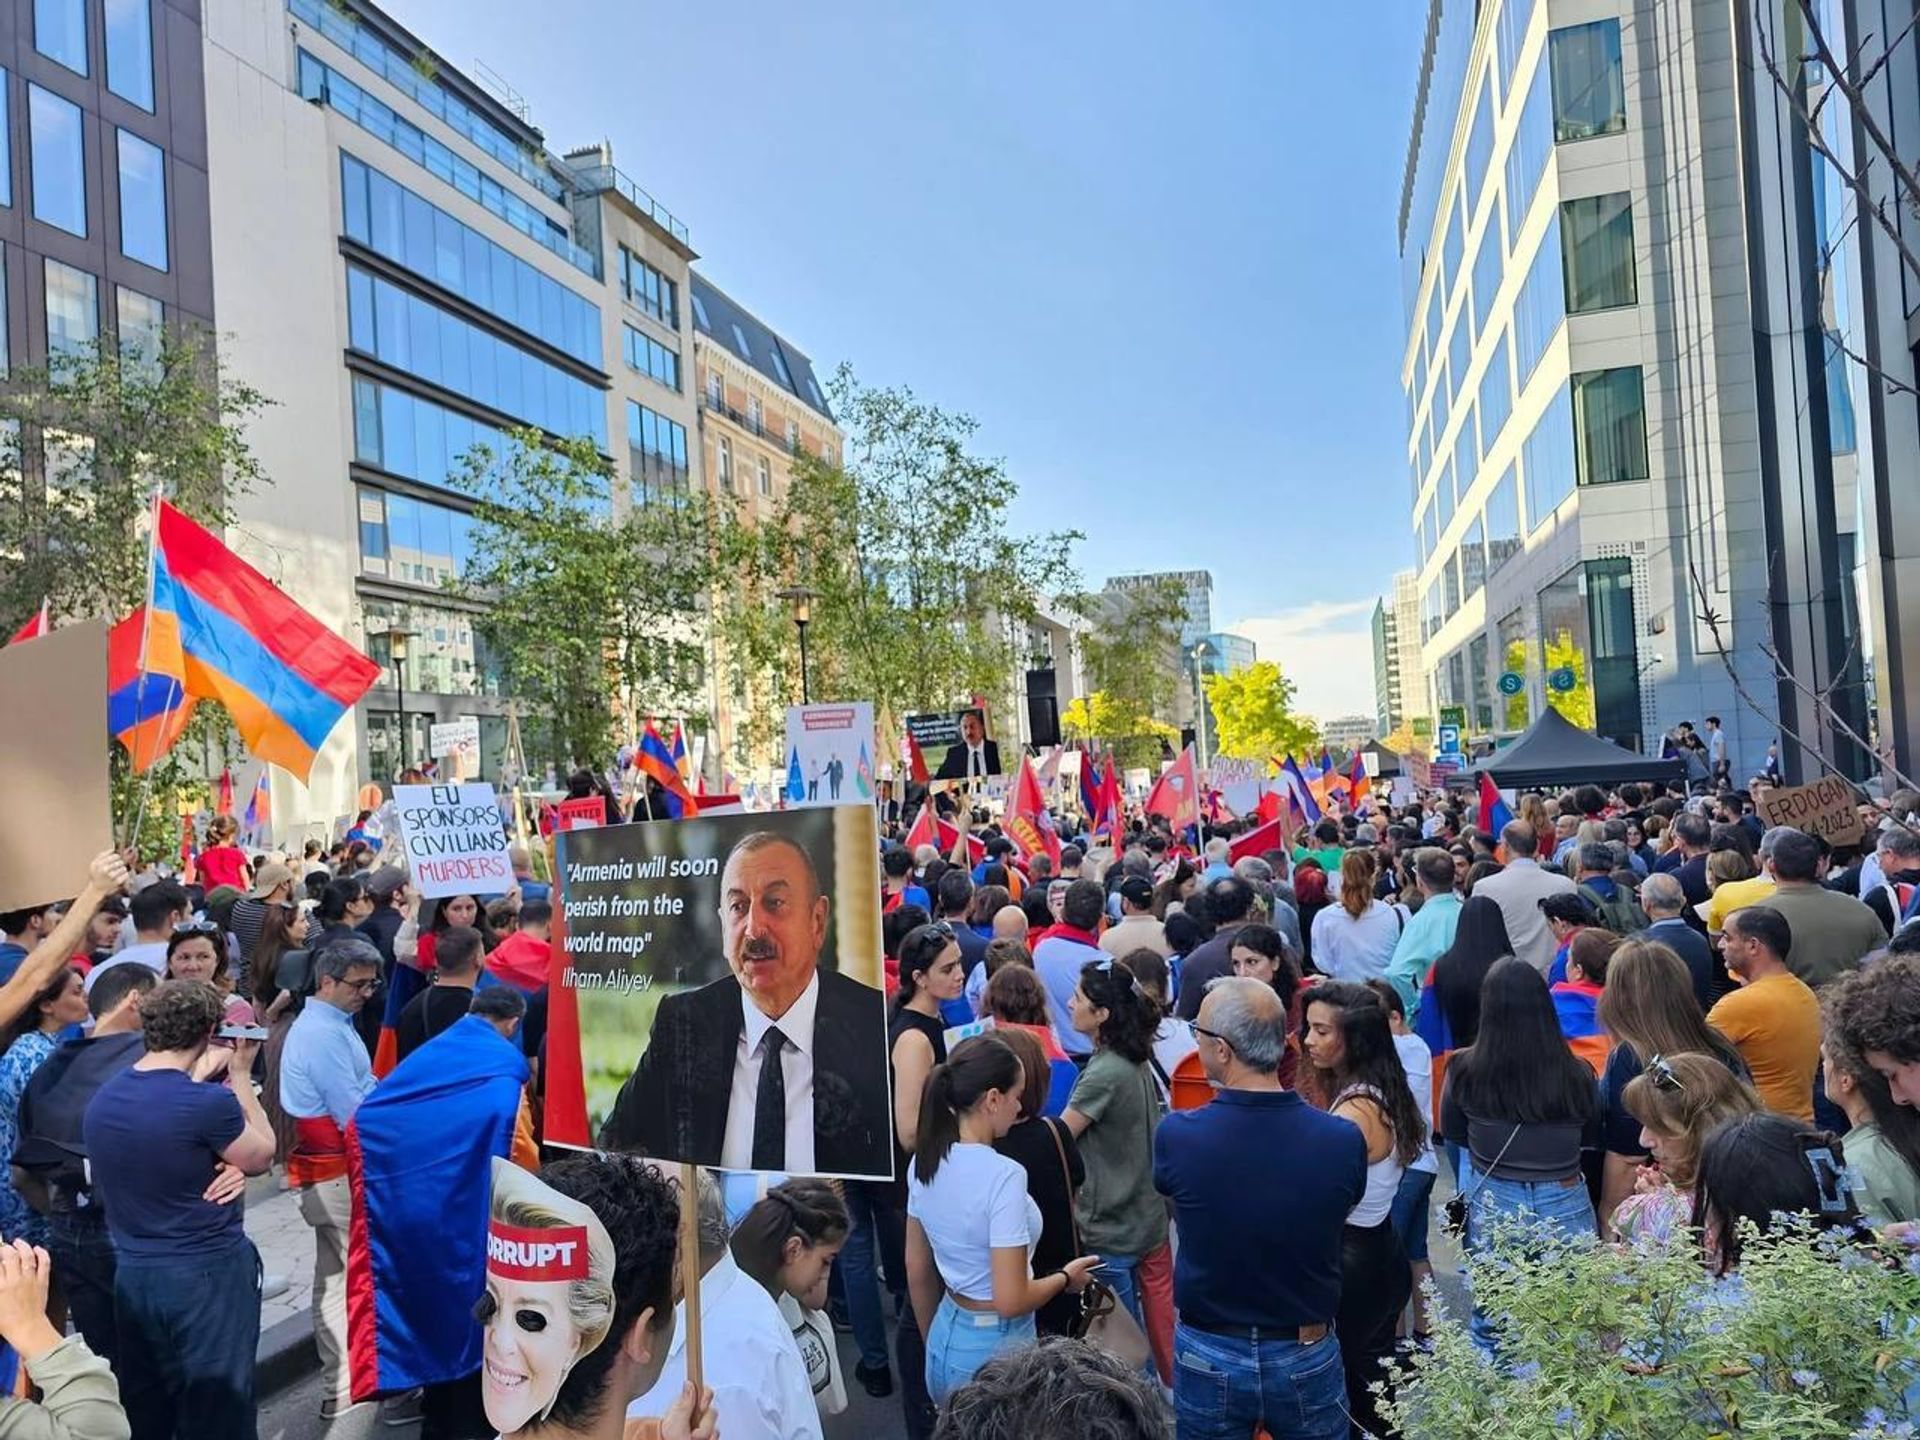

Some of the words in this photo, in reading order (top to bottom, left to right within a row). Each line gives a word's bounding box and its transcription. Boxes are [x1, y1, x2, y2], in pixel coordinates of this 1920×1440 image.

[1442, 730, 1456, 751] P
[431, 786, 460, 805] EU
[1766, 778, 1849, 827] ERDOGAN
[403, 805, 500, 831] SPONSORS
[419, 858, 505, 883] MURDERS
[567, 858, 632, 883] "Armenia
[637, 855, 667, 878] will
[669, 857, 719, 877] soon
[563, 894, 607, 922] perish
[610, 895, 649, 917] from
[653, 893, 684, 915] the
[563, 931, 604, 953] world
[606, 932, 652, 959] map"
[562, 967, 602, 988] Ilham
[604, 968, 653, 996] Aliyev
[487, 1231, 577, 1267] ORRUPT
